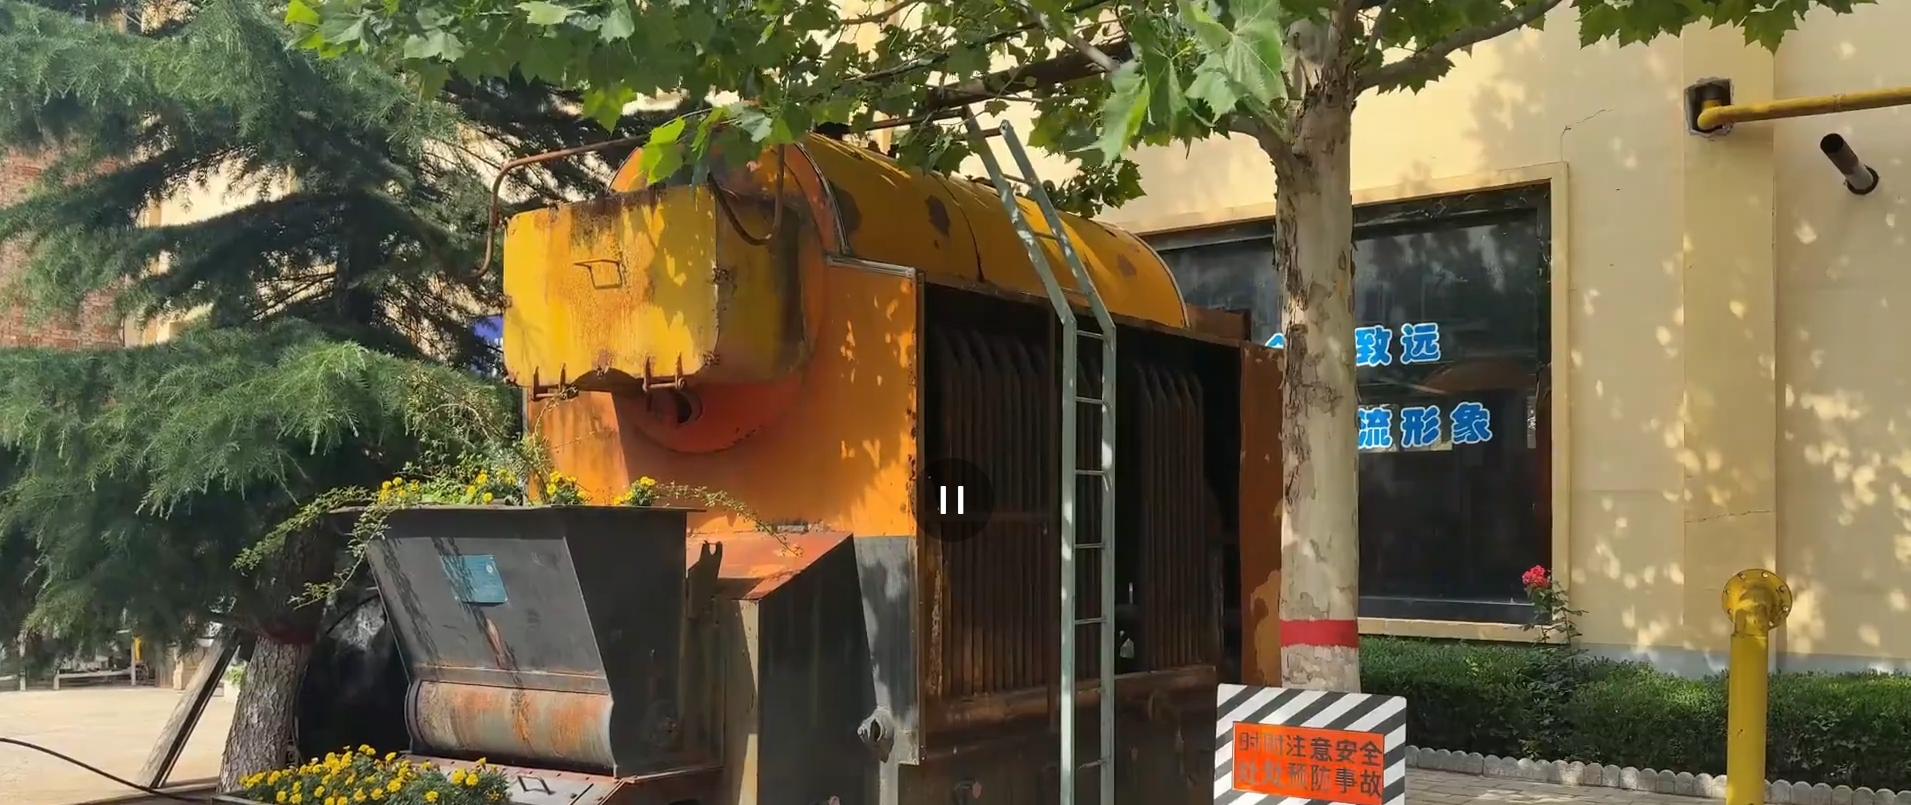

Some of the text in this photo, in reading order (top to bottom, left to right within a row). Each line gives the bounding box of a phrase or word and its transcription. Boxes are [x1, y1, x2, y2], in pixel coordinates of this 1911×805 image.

[1355, 322, 1441, 366] 致远
[1357, 401, 1493, 449] 流形象
[1239, 731, 1382, 767] 时时注意安全
